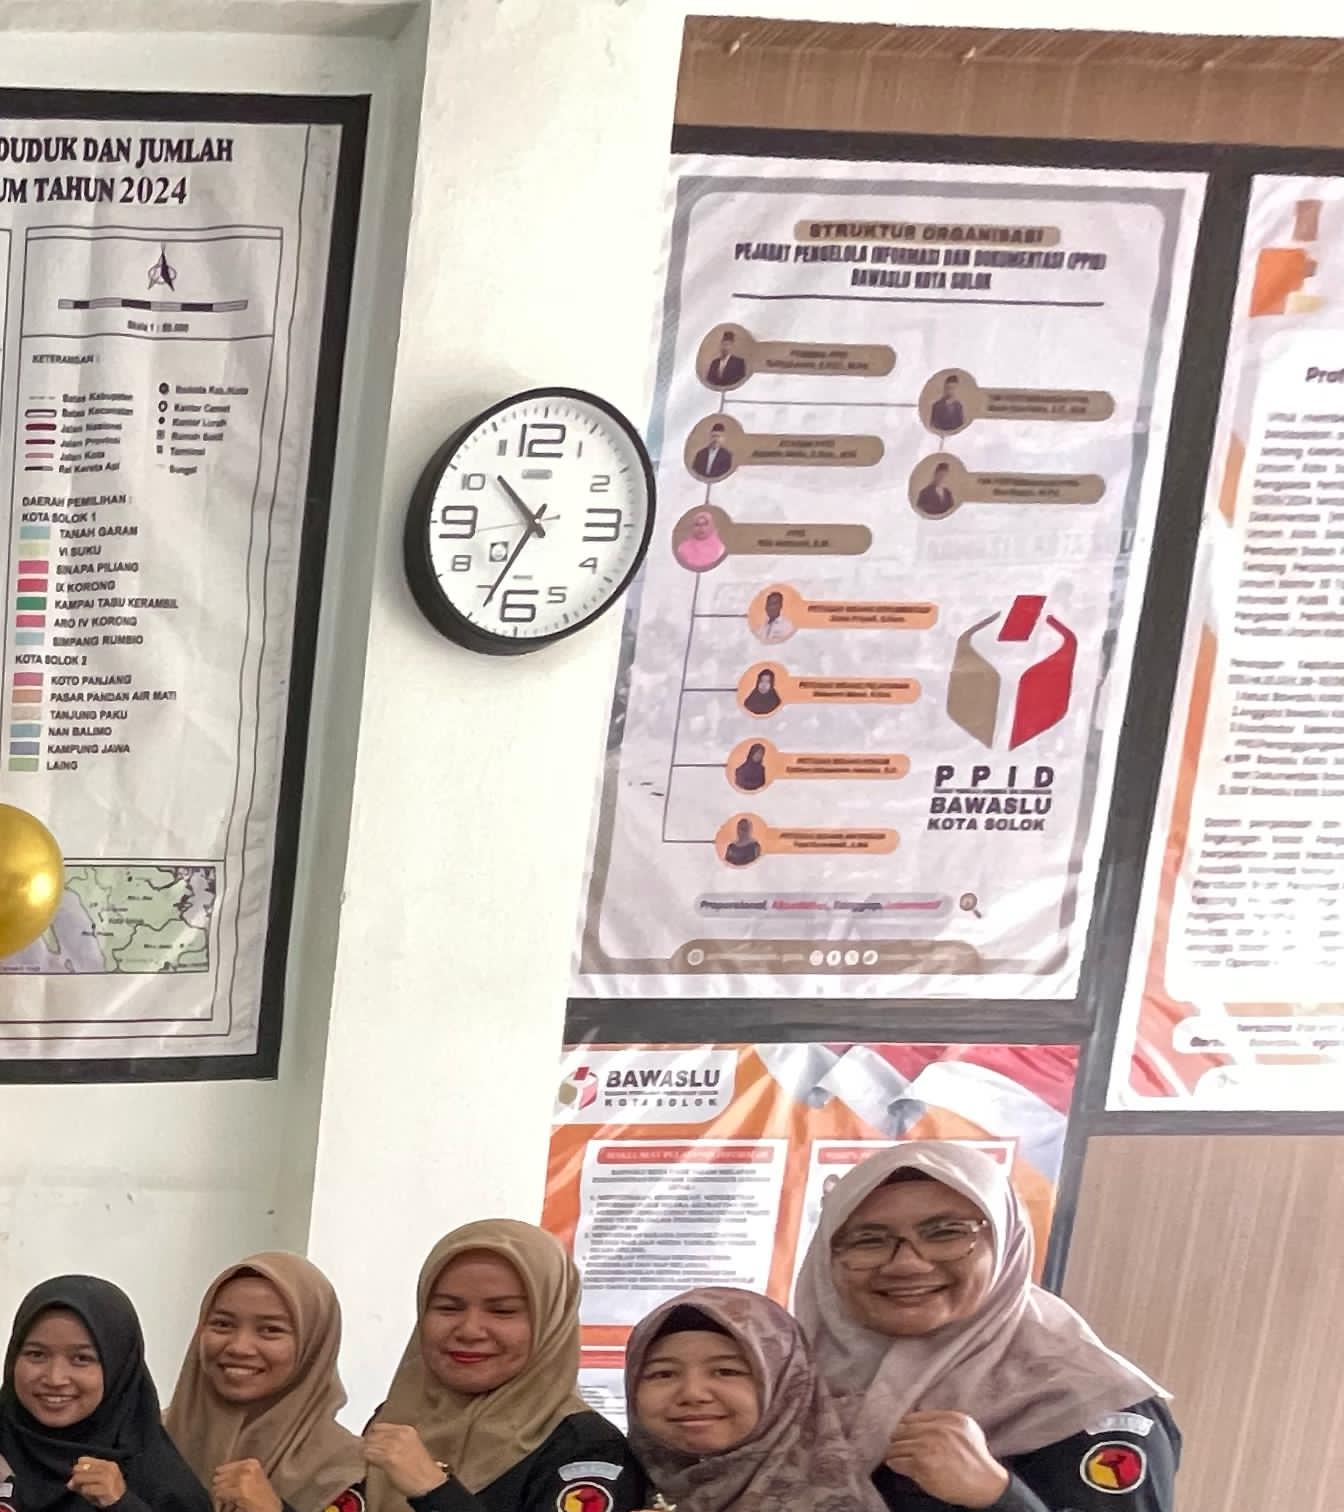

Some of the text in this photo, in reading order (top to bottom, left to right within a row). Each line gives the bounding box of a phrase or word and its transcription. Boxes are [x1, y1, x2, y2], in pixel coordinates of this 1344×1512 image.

[82, 137, 131, 162] DAN
[135, 137, 233, 168] JUMLAH
[34, 177, 113, 203] TAHUN
[119, 178, 187, 204] 2024
[810, 223, 1044, 244] STRUKTUR ORGANISASI
[518, 424, 566, 458] 12
[462, 472, 486, 491] 10
[590, 474, 611, 493] 2
[22, 495, 127, 507] DAERAH PEMILIHAN
[22, 512, 50, 523] KOTA
[52, 512, 88, 523] SOLOK
[439, 505, 478, 539] 9
[582, 508, 622, 542] 3
[59, 526, 138, 538] TANAH GARAM
[70, 545, 102, 557] SUKU
[451, 554, 472, 572] 8
[578, 557, 599, 575] 4
[67, 581, 116, 593] KORONG
[546, 586, 568, 604] 5
[500, 589, 540, 623] 6
[16, 654, 88, 666] KOTA SOLOK 2
[82, 675, 132, 686] PANJANG
[50, 710, 97, 721] TANJUNG
[48, 726, 70, 737] NAN
[47, 743, 130, 754] KAMPUNG JAWA
[930, 797, 1053, 815] BAWASLU
[927, 818, 1046, 831] KOTA SOLOK
[606, 1069, 721, 1088] BAWASLU
